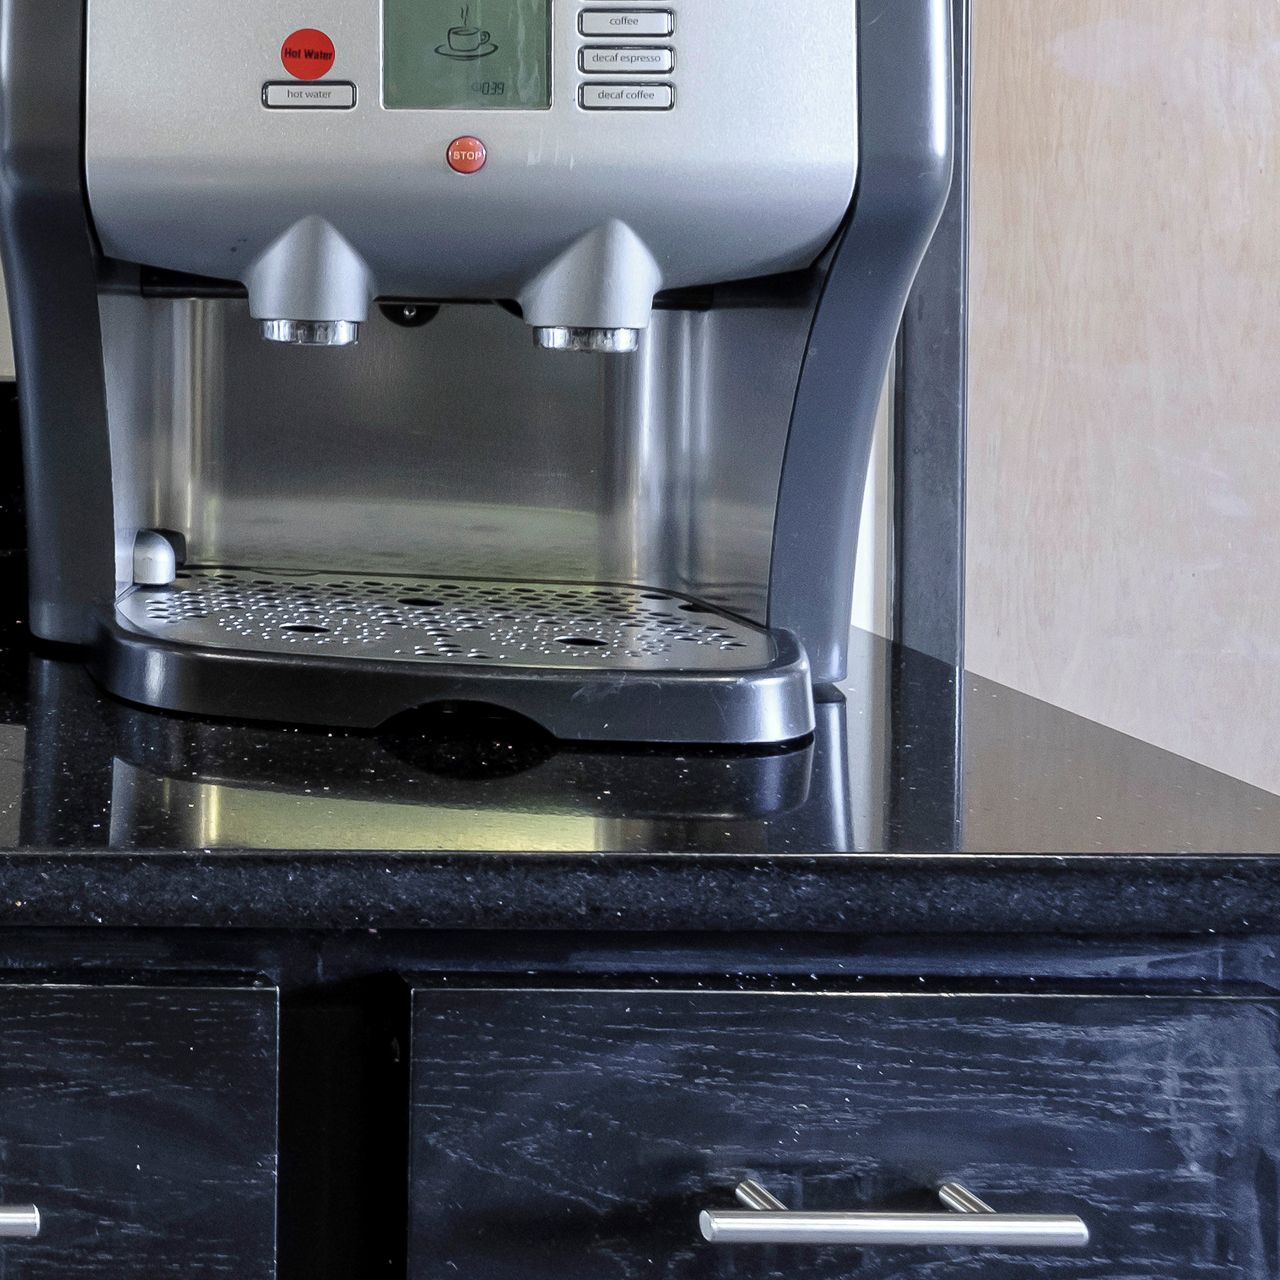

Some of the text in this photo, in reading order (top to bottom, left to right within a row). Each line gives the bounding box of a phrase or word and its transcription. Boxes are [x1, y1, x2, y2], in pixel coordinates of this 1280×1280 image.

[609, 16, 639, 26] coffee
[284, 47, 333, 60] Hot Water
[592, 53, 661, 64] decaf espresso
[287, 88, 332, 99] hot water
[597, 90, 655, 100] decaf coffee
[453, 150, 482, 161] STOP
